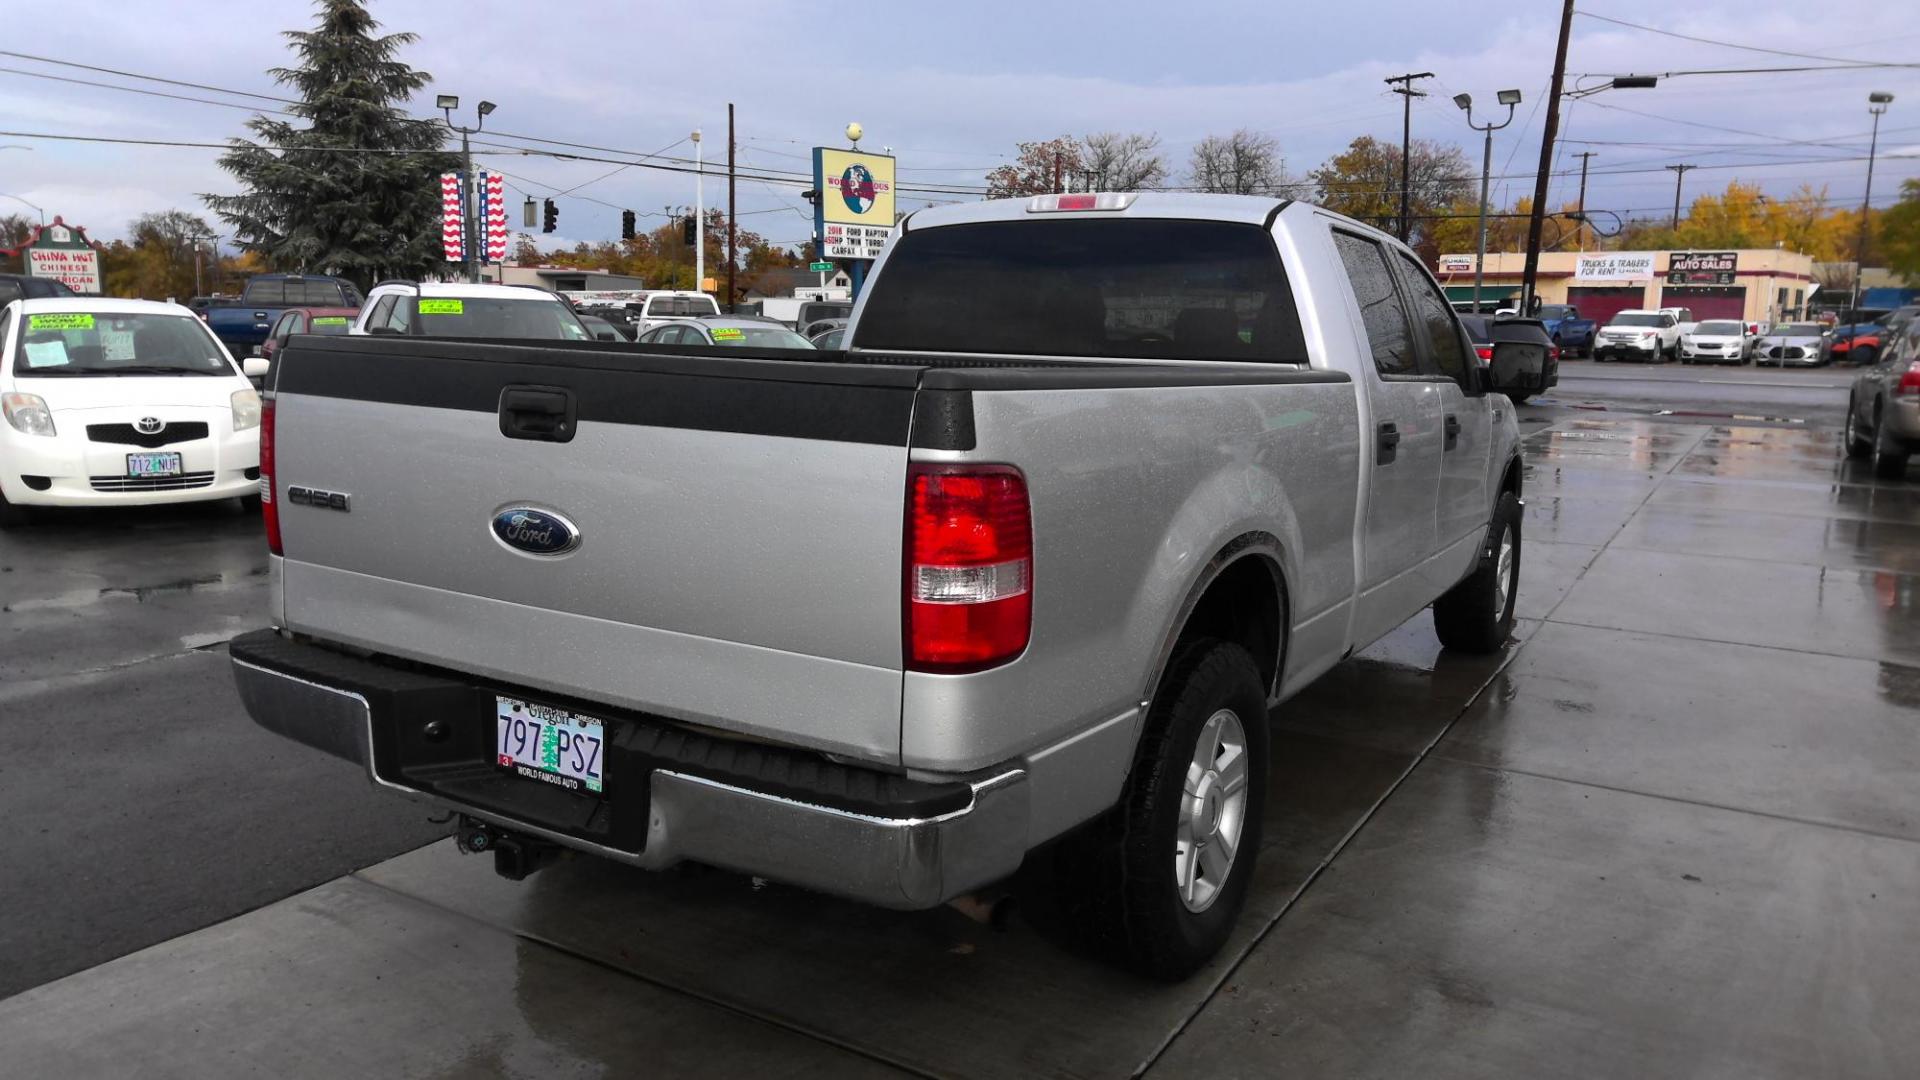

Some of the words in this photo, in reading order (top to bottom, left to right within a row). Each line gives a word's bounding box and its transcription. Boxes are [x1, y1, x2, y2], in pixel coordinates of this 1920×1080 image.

[847, 227, 861, 235] FORD
[866, 229, 889, 238] RAPTOR
[847, 238, 862, 246] TWIN
[865, 239, 885, 248] TURBO
[31, 251, 68, 262] CHINA
[73, 252, 94, 262] HUT
[832, 247, 855, 256] CARFAX
[40, 264, 88, 272] CHINESE
[1581, 259, 1606, 268] TRUCKS
[1618, 259, 1650, 268] TRAILERS
[1674, 260, 1699, 270] AUTO
[1701, 260, 1732, 270] SALES
[1581, 268, 1595, 276] FOR
[1598, 267, 1616, 276] RENT
[130, 459, 151, 472] 712
[158, 458, 178, 471] NUF
[507, 514, 552, 546] Ford
[500, 714, 541, 761] 797
[557, 728, 601, 779] PSZ
[502, 756, 509, 767] 3
[517, 766, 538, 779] WORLD
[538, 771, 562, 785] FAMOUS
[562, 778, 578, 790] AUTO
